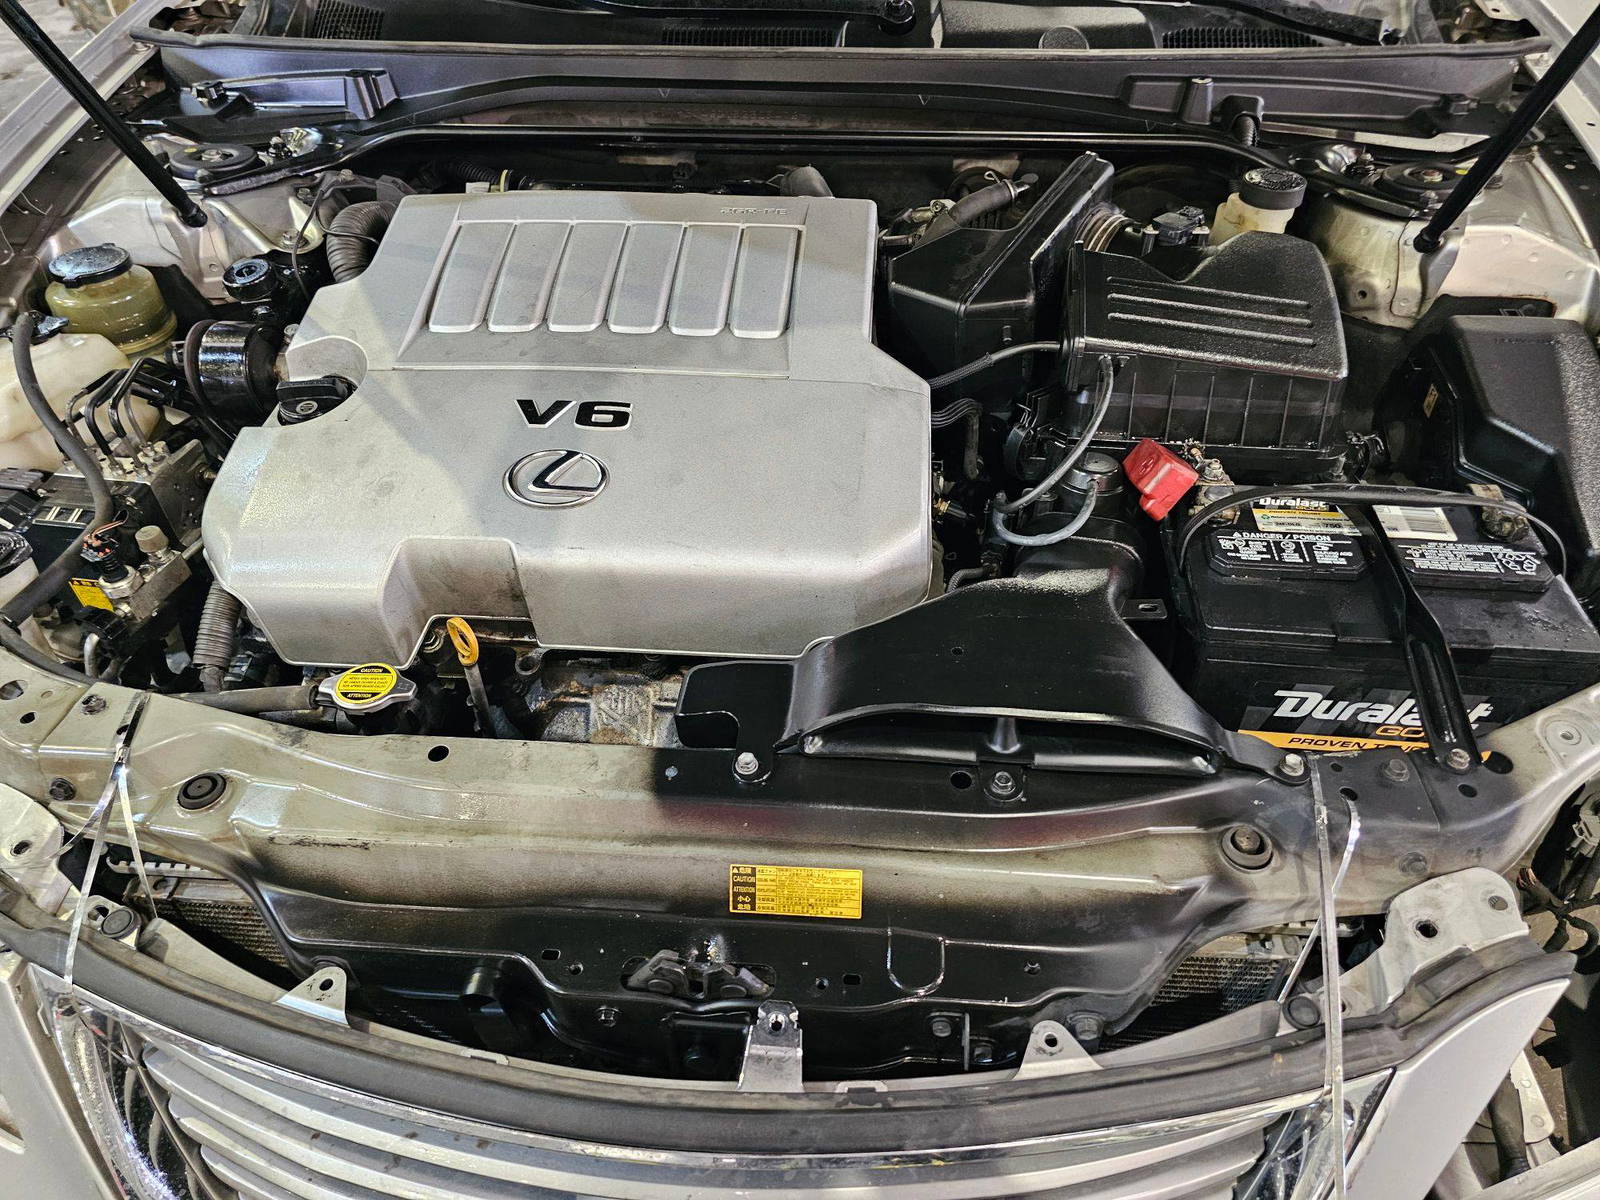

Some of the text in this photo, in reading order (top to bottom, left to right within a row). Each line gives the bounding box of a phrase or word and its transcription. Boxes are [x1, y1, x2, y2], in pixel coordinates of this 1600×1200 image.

[514, 398, 633, 431] V6
[1242, 531, 1283, 540] DANGER
[1293, 534, 1332, 542] POISON
[1274, 689, 1493, 730] Duralat
[1288, 737, 1367, 750] PROVEN
